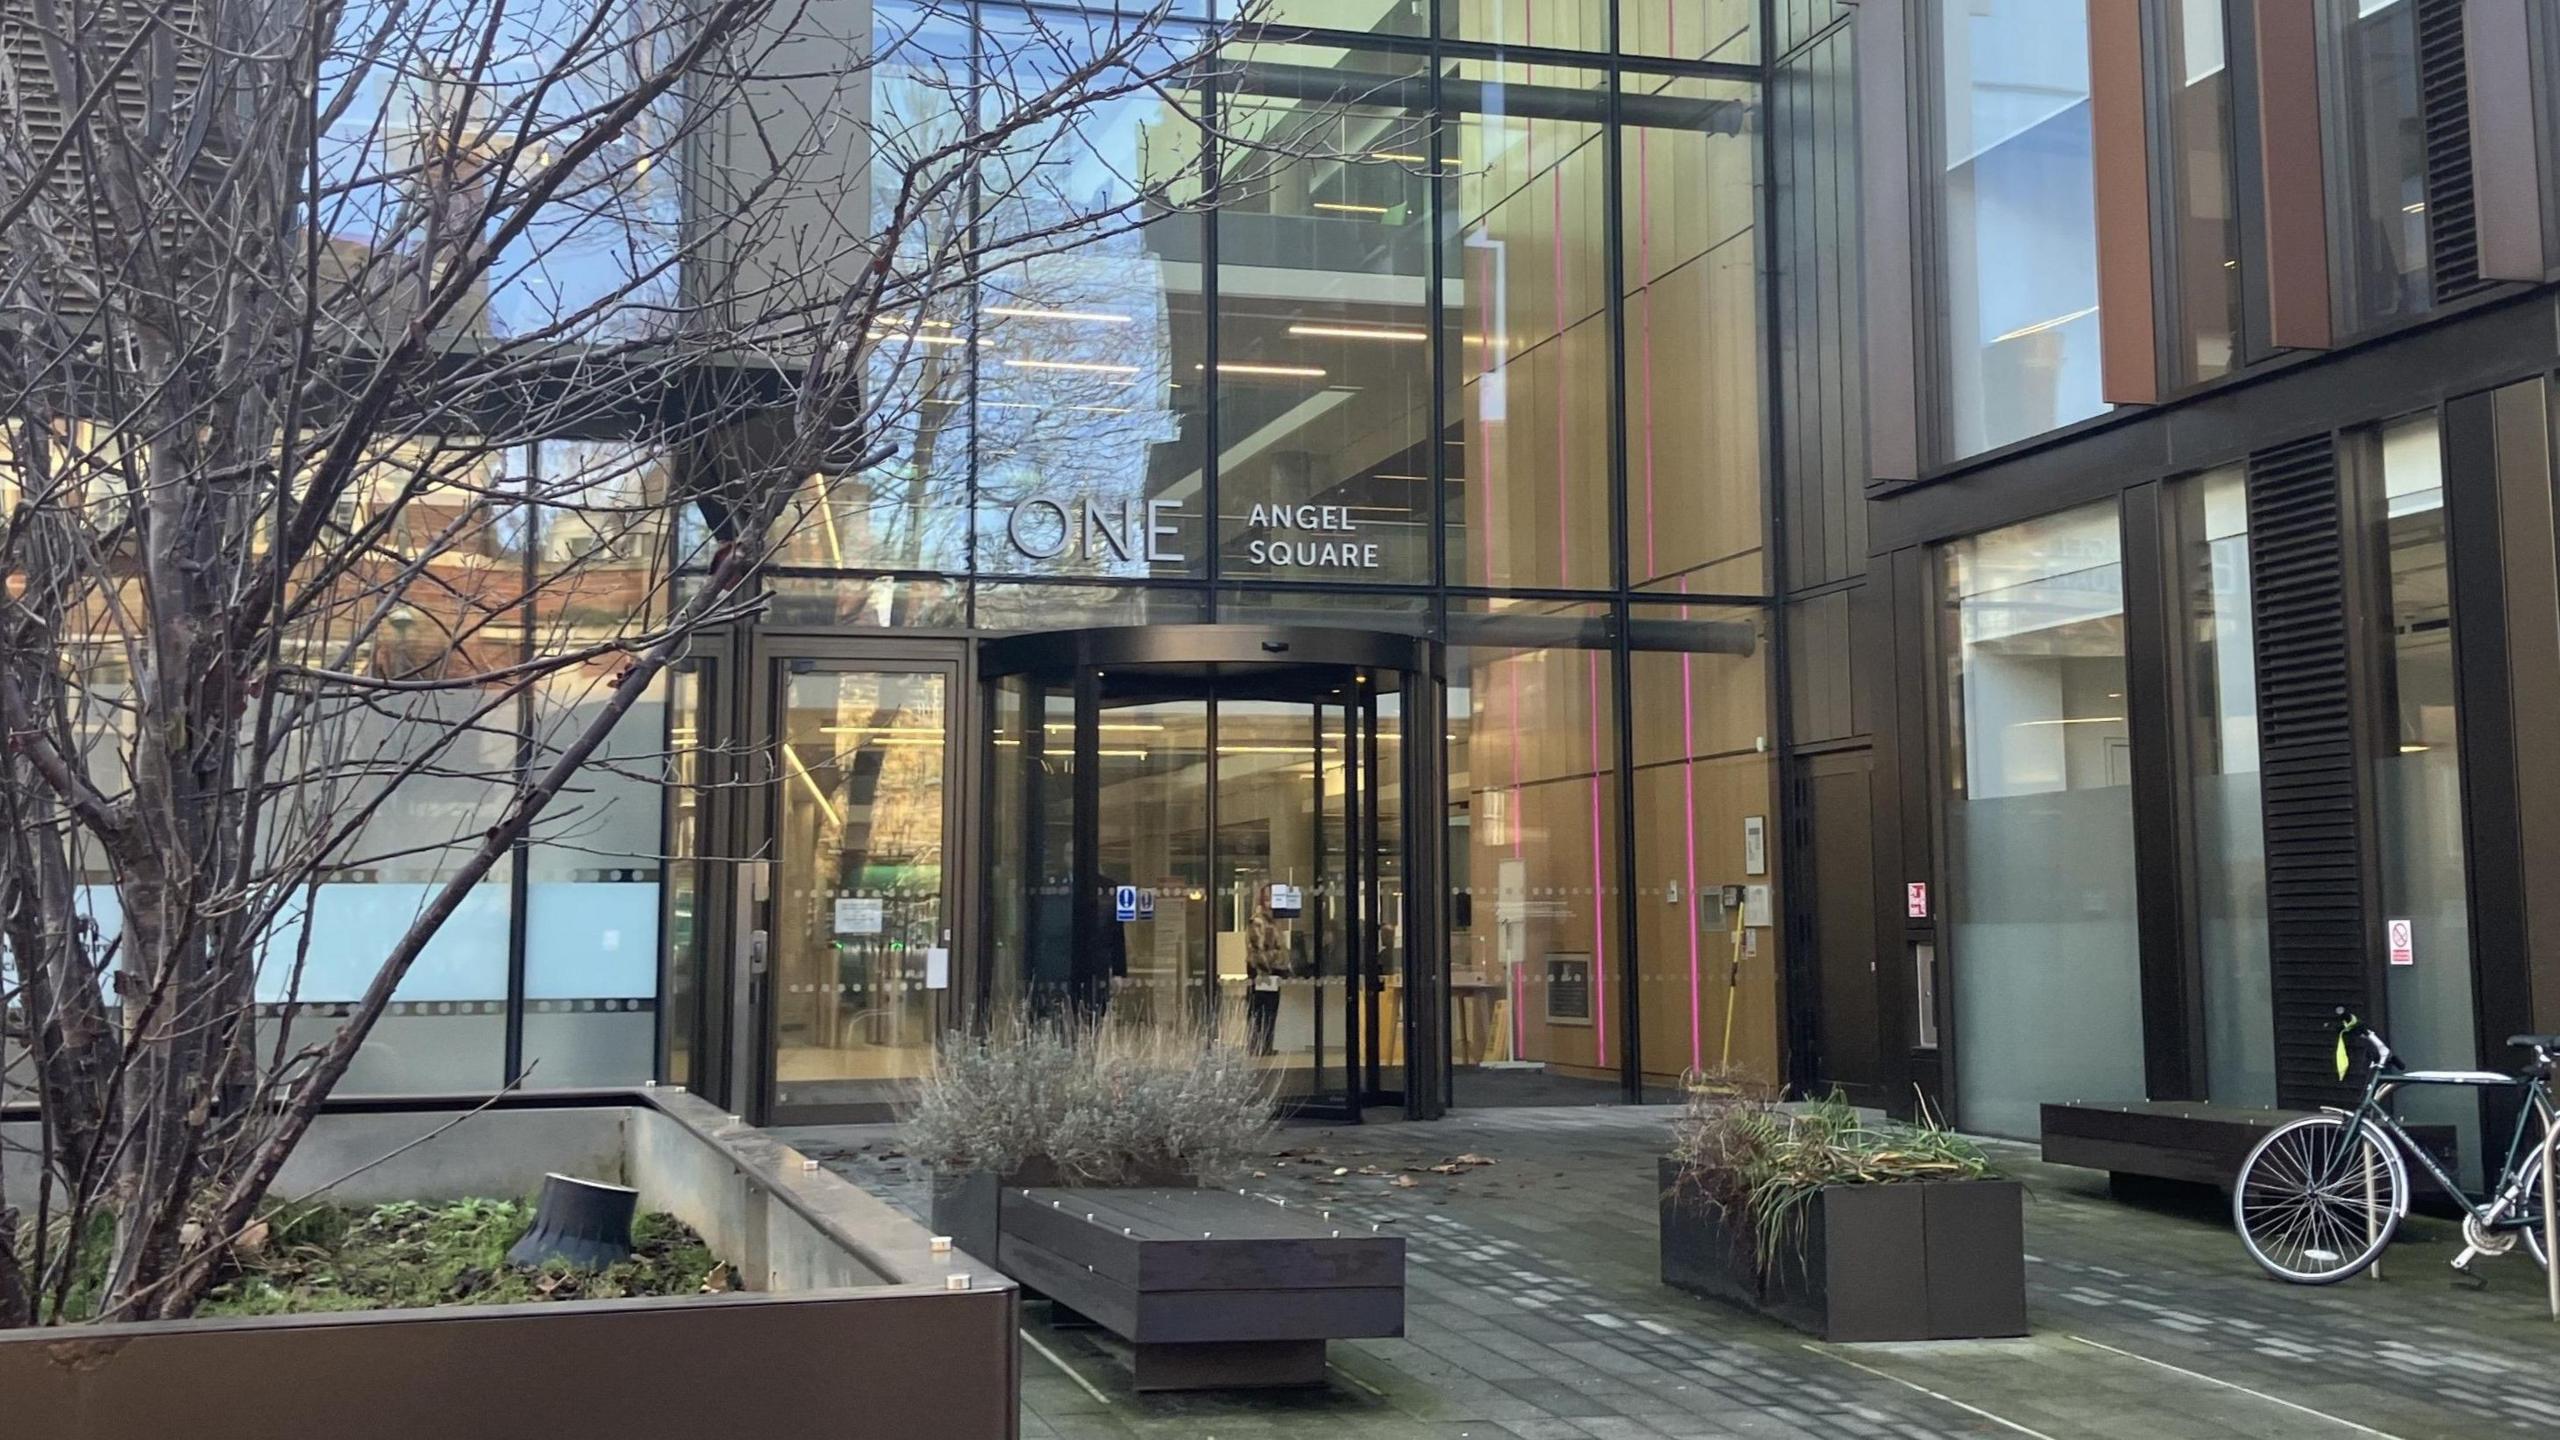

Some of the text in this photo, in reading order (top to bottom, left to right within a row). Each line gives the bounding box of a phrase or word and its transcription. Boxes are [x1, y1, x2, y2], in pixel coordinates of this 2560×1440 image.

[1009, 496, 1185, 562] ONE
[1248, 503, 1357, 531] ANGEL
[1248, 540, 1379, 568] SQUARE
